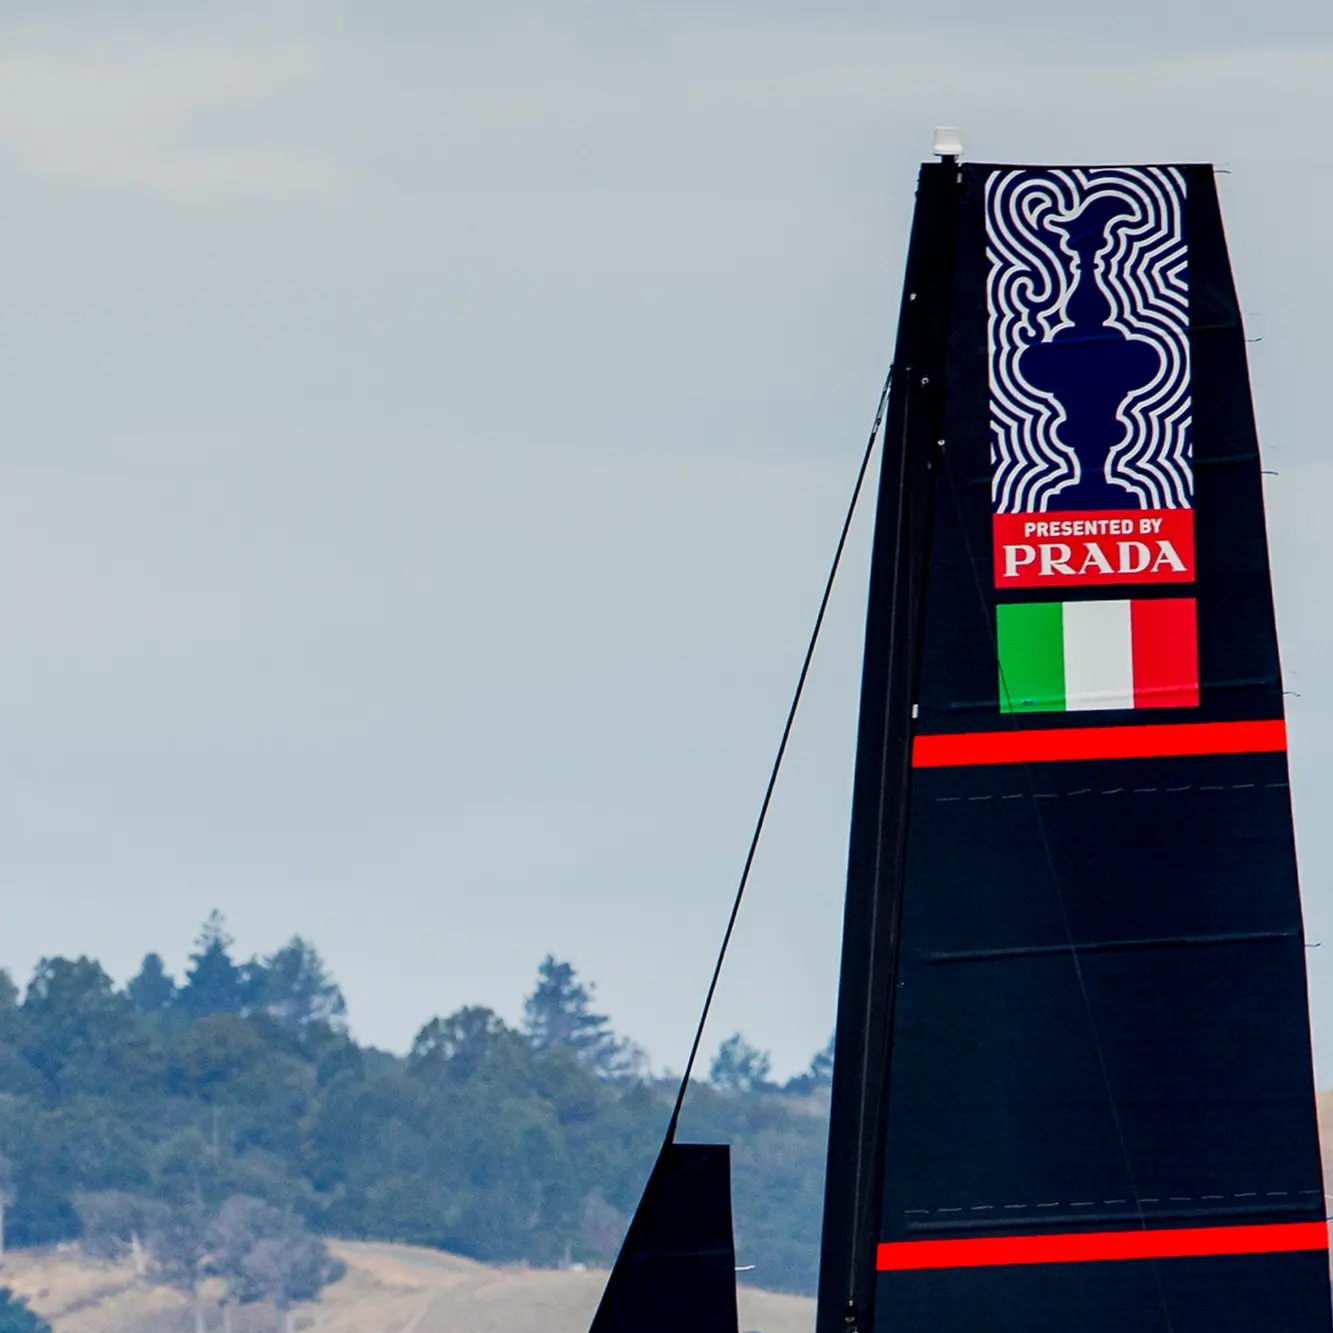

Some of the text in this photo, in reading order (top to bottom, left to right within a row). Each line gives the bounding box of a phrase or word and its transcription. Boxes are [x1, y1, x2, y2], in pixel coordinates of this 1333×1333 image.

[1024, 518, 1162, 537] PRESENTED BY
[1003, 540, 1187, 577] PRADA
